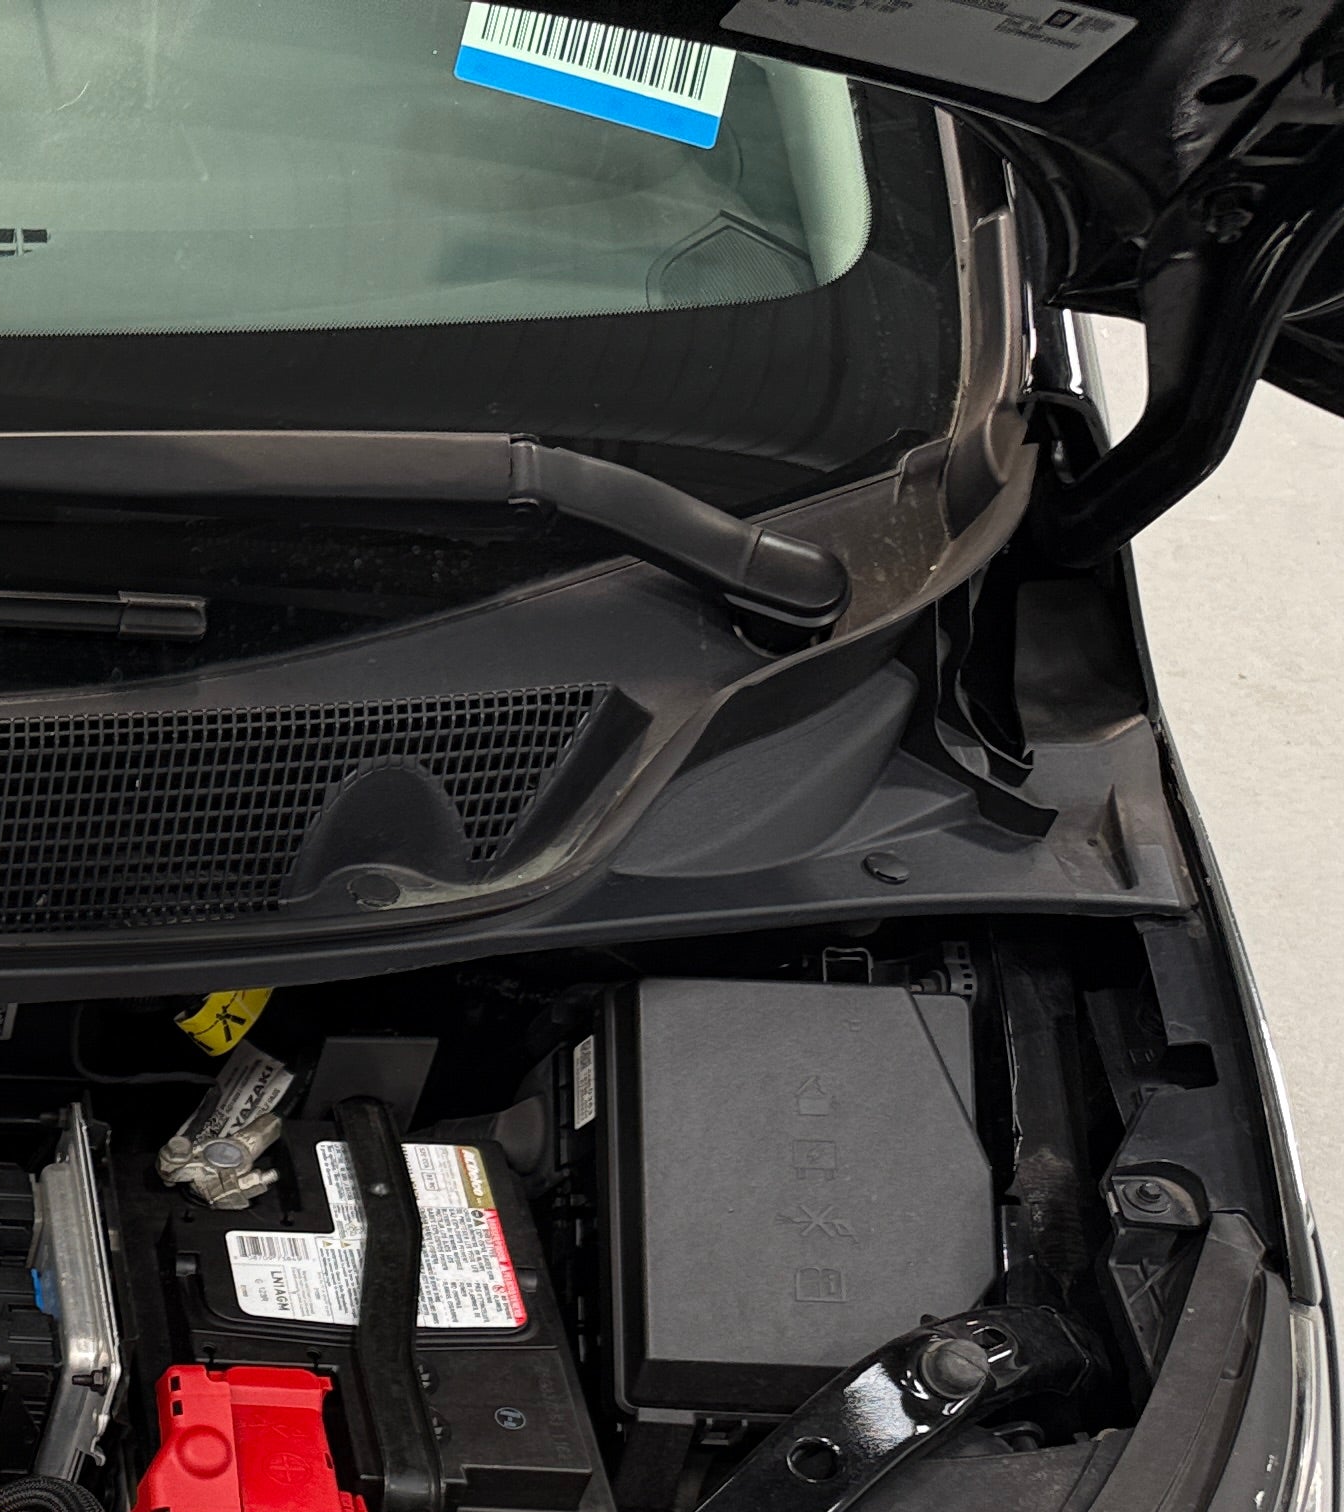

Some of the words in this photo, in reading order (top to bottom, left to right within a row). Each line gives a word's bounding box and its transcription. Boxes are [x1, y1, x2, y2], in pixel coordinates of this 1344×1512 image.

[230, 1065, 274, 1129] YAZAKI
[460, 1148, 486, 1196] ACDelco
[269, 1270, 290, 1310] LN1AGM
